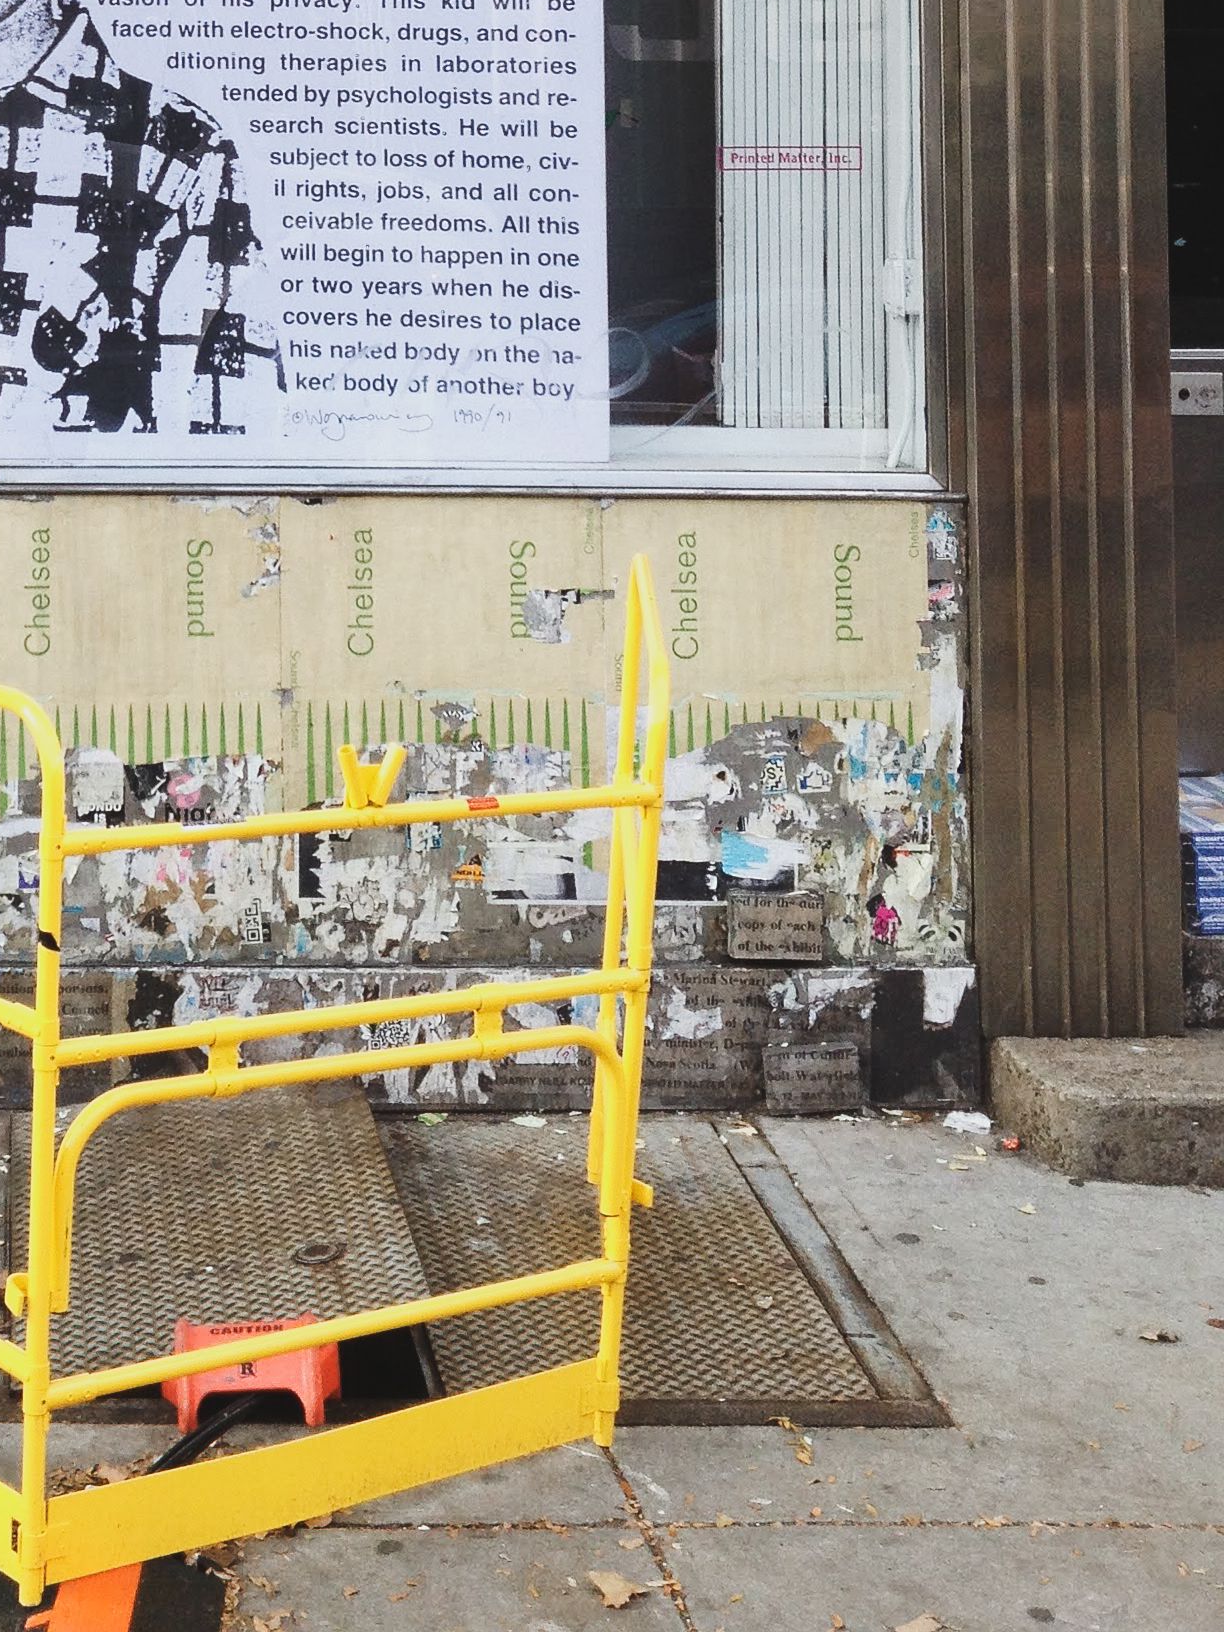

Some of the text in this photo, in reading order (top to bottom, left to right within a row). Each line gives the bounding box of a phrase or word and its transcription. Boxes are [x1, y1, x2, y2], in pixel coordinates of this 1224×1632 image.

[110, 19, 577, 47] faced with electro-shock, drugs, and con-
[269, 147, 579, 173] subject to loss of home, civ-
[731, 152, 774, 164] Printed
[829, 152, 853, 164] Inc.
[282, 307, 581, 336] covers he desires to place
[24, 527, 52, 656] Chelsea
[185, 538, 215, 638] Sound
[347, 526, 375, 656] Chelsea
[671, 531, 699, 660] Chelsea
[833, 543, 864, 643] Sound
[771, 919, 783, 931] of
[737, 942, 750, 953] of
[755, 942, 774, 954] the
[209, 1324, 284, 1335] CAUTION
